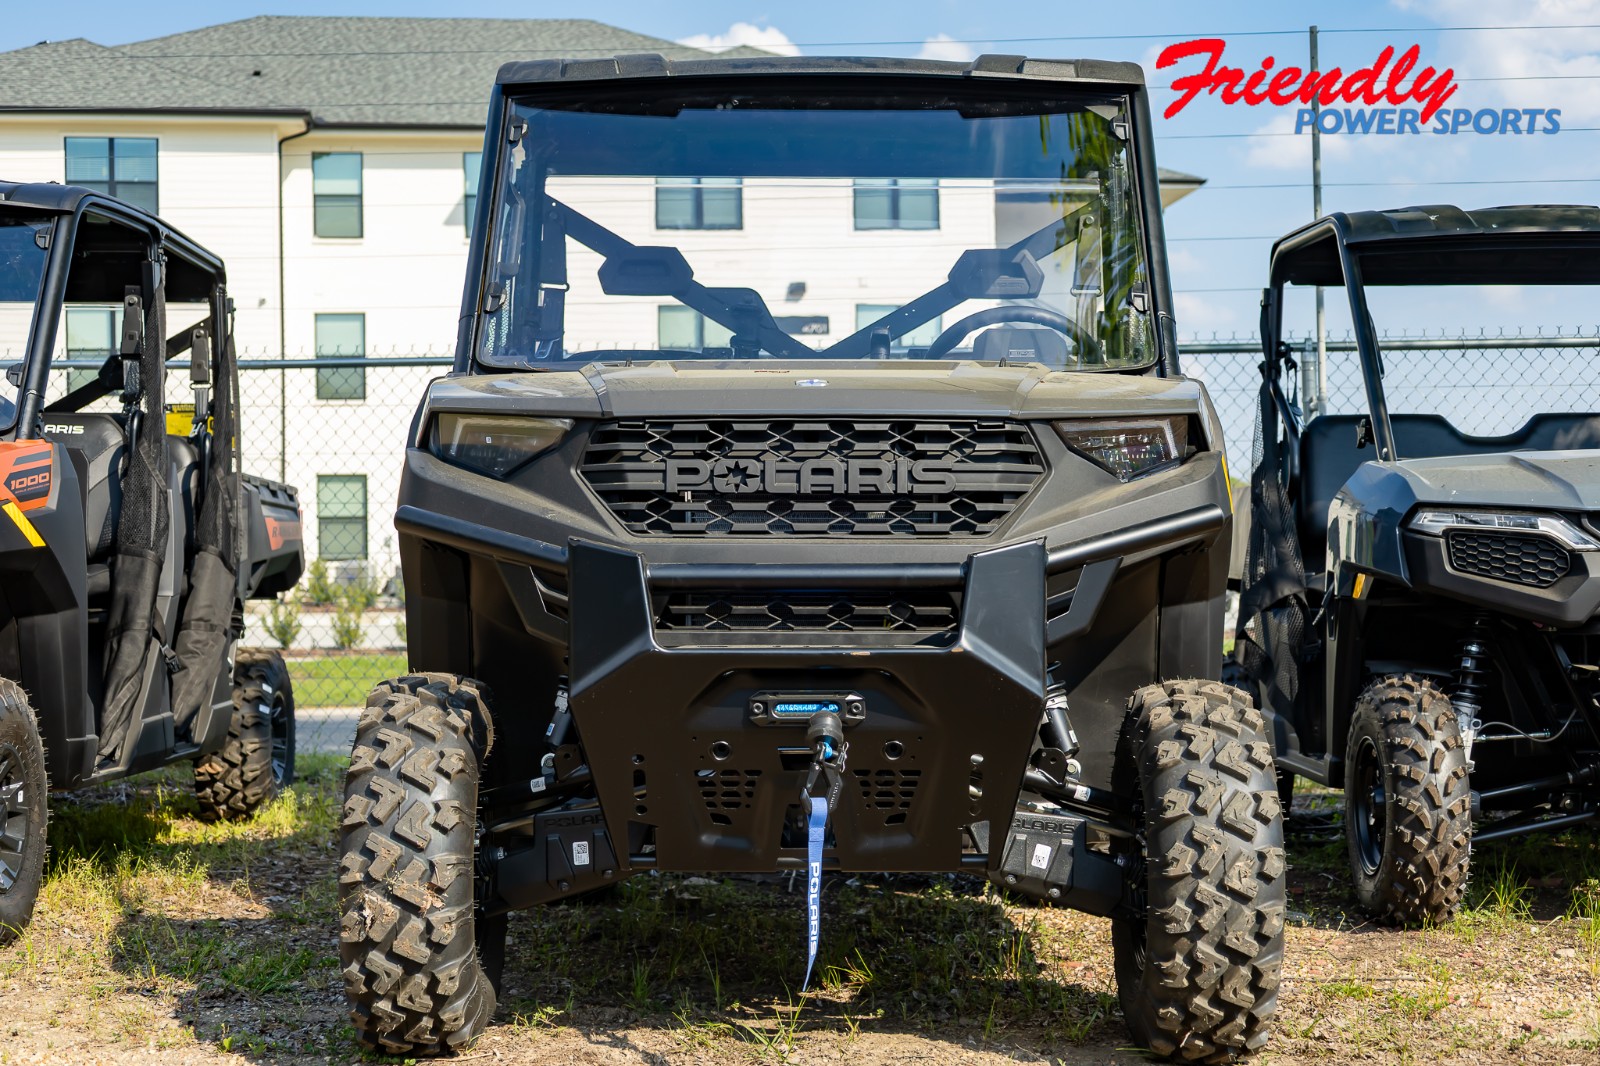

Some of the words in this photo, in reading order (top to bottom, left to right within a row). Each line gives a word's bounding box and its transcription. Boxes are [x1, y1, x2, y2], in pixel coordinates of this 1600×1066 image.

[44, 424, 85, 434] ARIS
[10, 472, 50, 490] 1000
[665, 459, 957, 494] POLARIS
[810, 862, 820, 956] POLARIS
